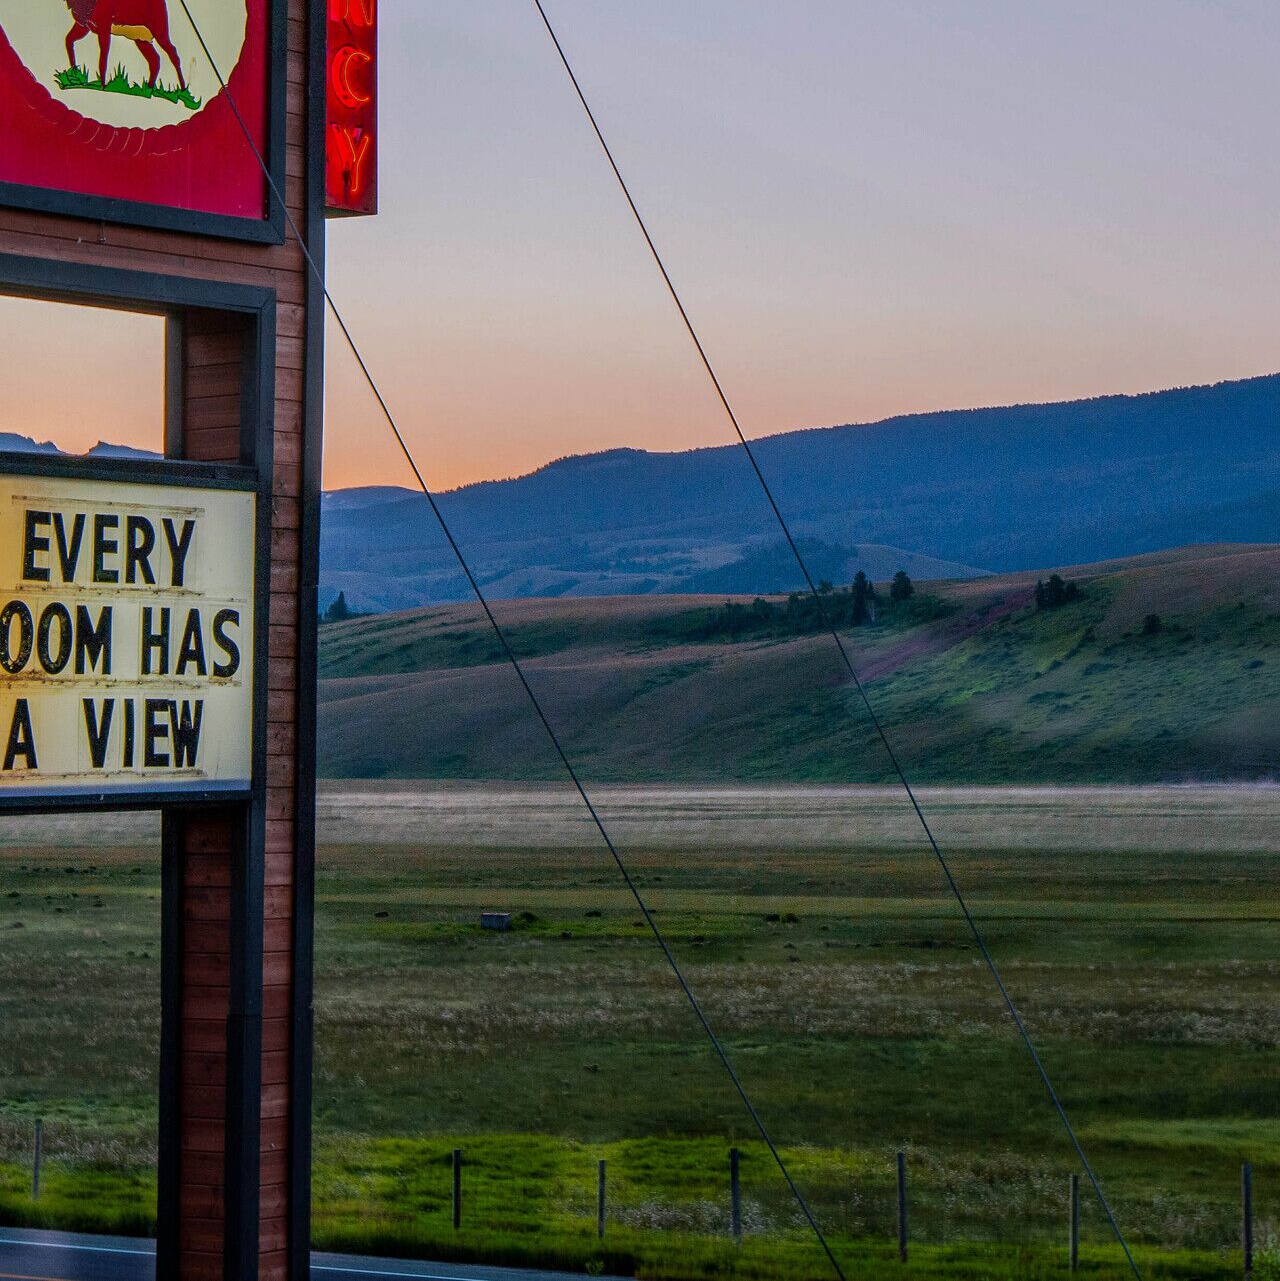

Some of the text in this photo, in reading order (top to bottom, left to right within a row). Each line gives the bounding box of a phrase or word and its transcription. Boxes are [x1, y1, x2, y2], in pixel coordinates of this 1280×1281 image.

[22, 509, 197, 587] EVERY
[141, 606, 241, 678] HAS
[2, 698, 204, 770] A VIEW
